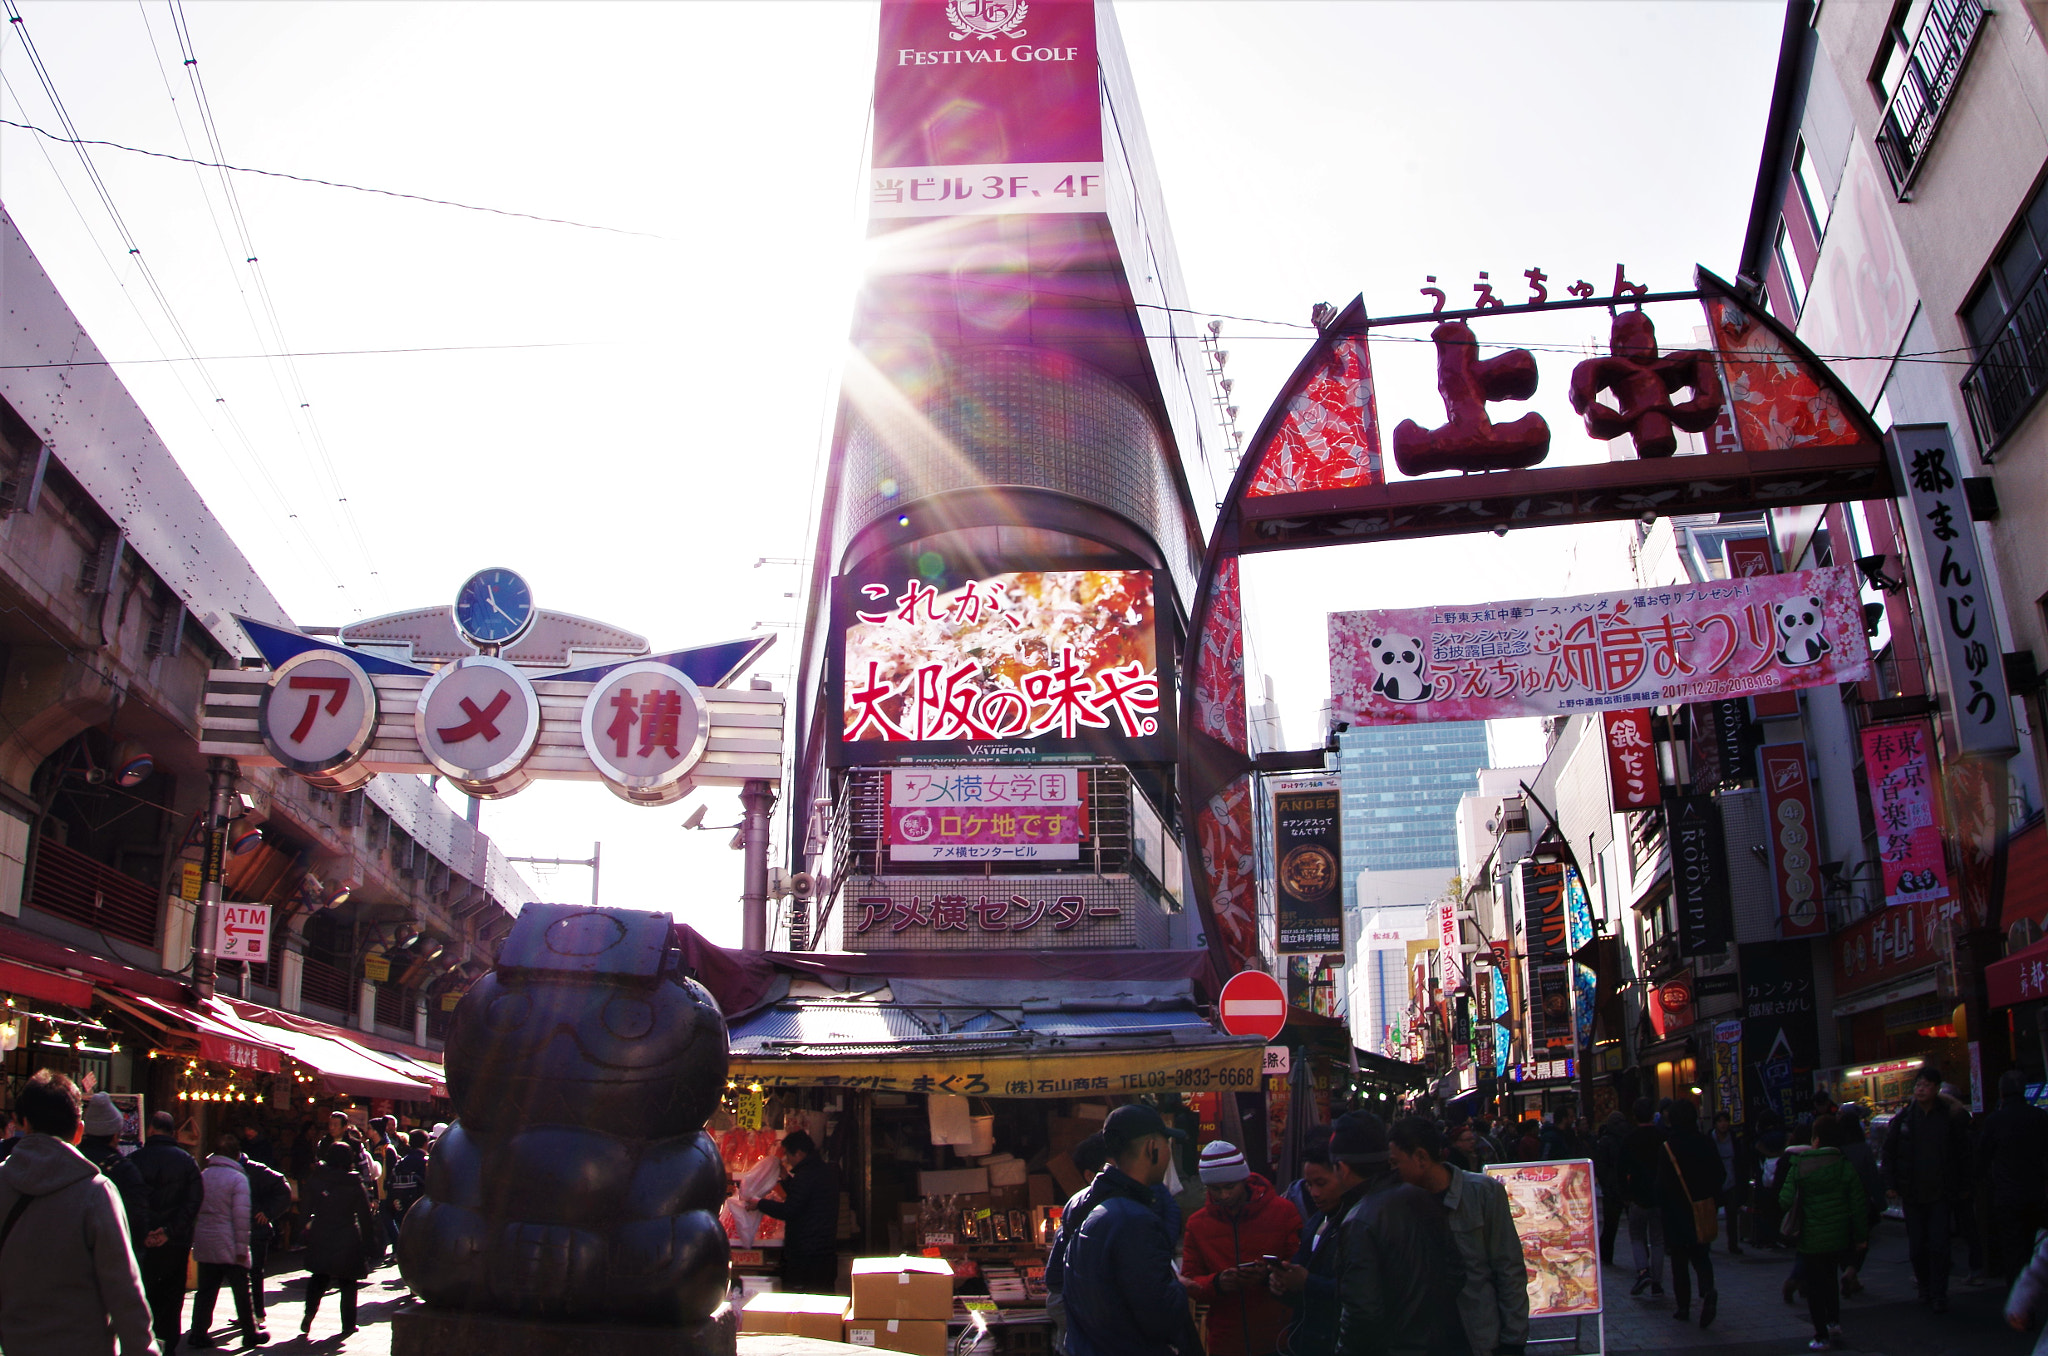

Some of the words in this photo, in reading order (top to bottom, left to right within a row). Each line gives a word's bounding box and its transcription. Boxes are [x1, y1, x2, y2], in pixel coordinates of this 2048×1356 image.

[897, 48, 1007, 66] FESTIVAL
[1011, 45, 1078, 63] GOLF
[1420, 263, 1648, 313] うえちゅん
[1910, 448, 1997, 725] 都まんじゅう
[857, 579, 1023, 629] これが、
[1432, 627, 1526, 645] シャンシャン
[1433, 641, 1529, 660] お披露目記念
[842, 646, 1160, 741] 大阪の味や。
[288, 675, 682, 760] アメ横
[1609, 719, 1651, 803] 銀だこ
[905, 774, 1067, 802] アメ横女学園
[940, 813, 1068, 837] ロケ地です
[933, 846, 1038, 858] アメ横センタービル
[1681, 830, 1707, 949] ROOMPIA
[224, 907, 266, 925] ATM
[857, 894, 1121, 931] アメ横センター
[911, 1073, 990, 1094] まぐろ
[1521, 1060, 1566, 1081] 大黒屋
